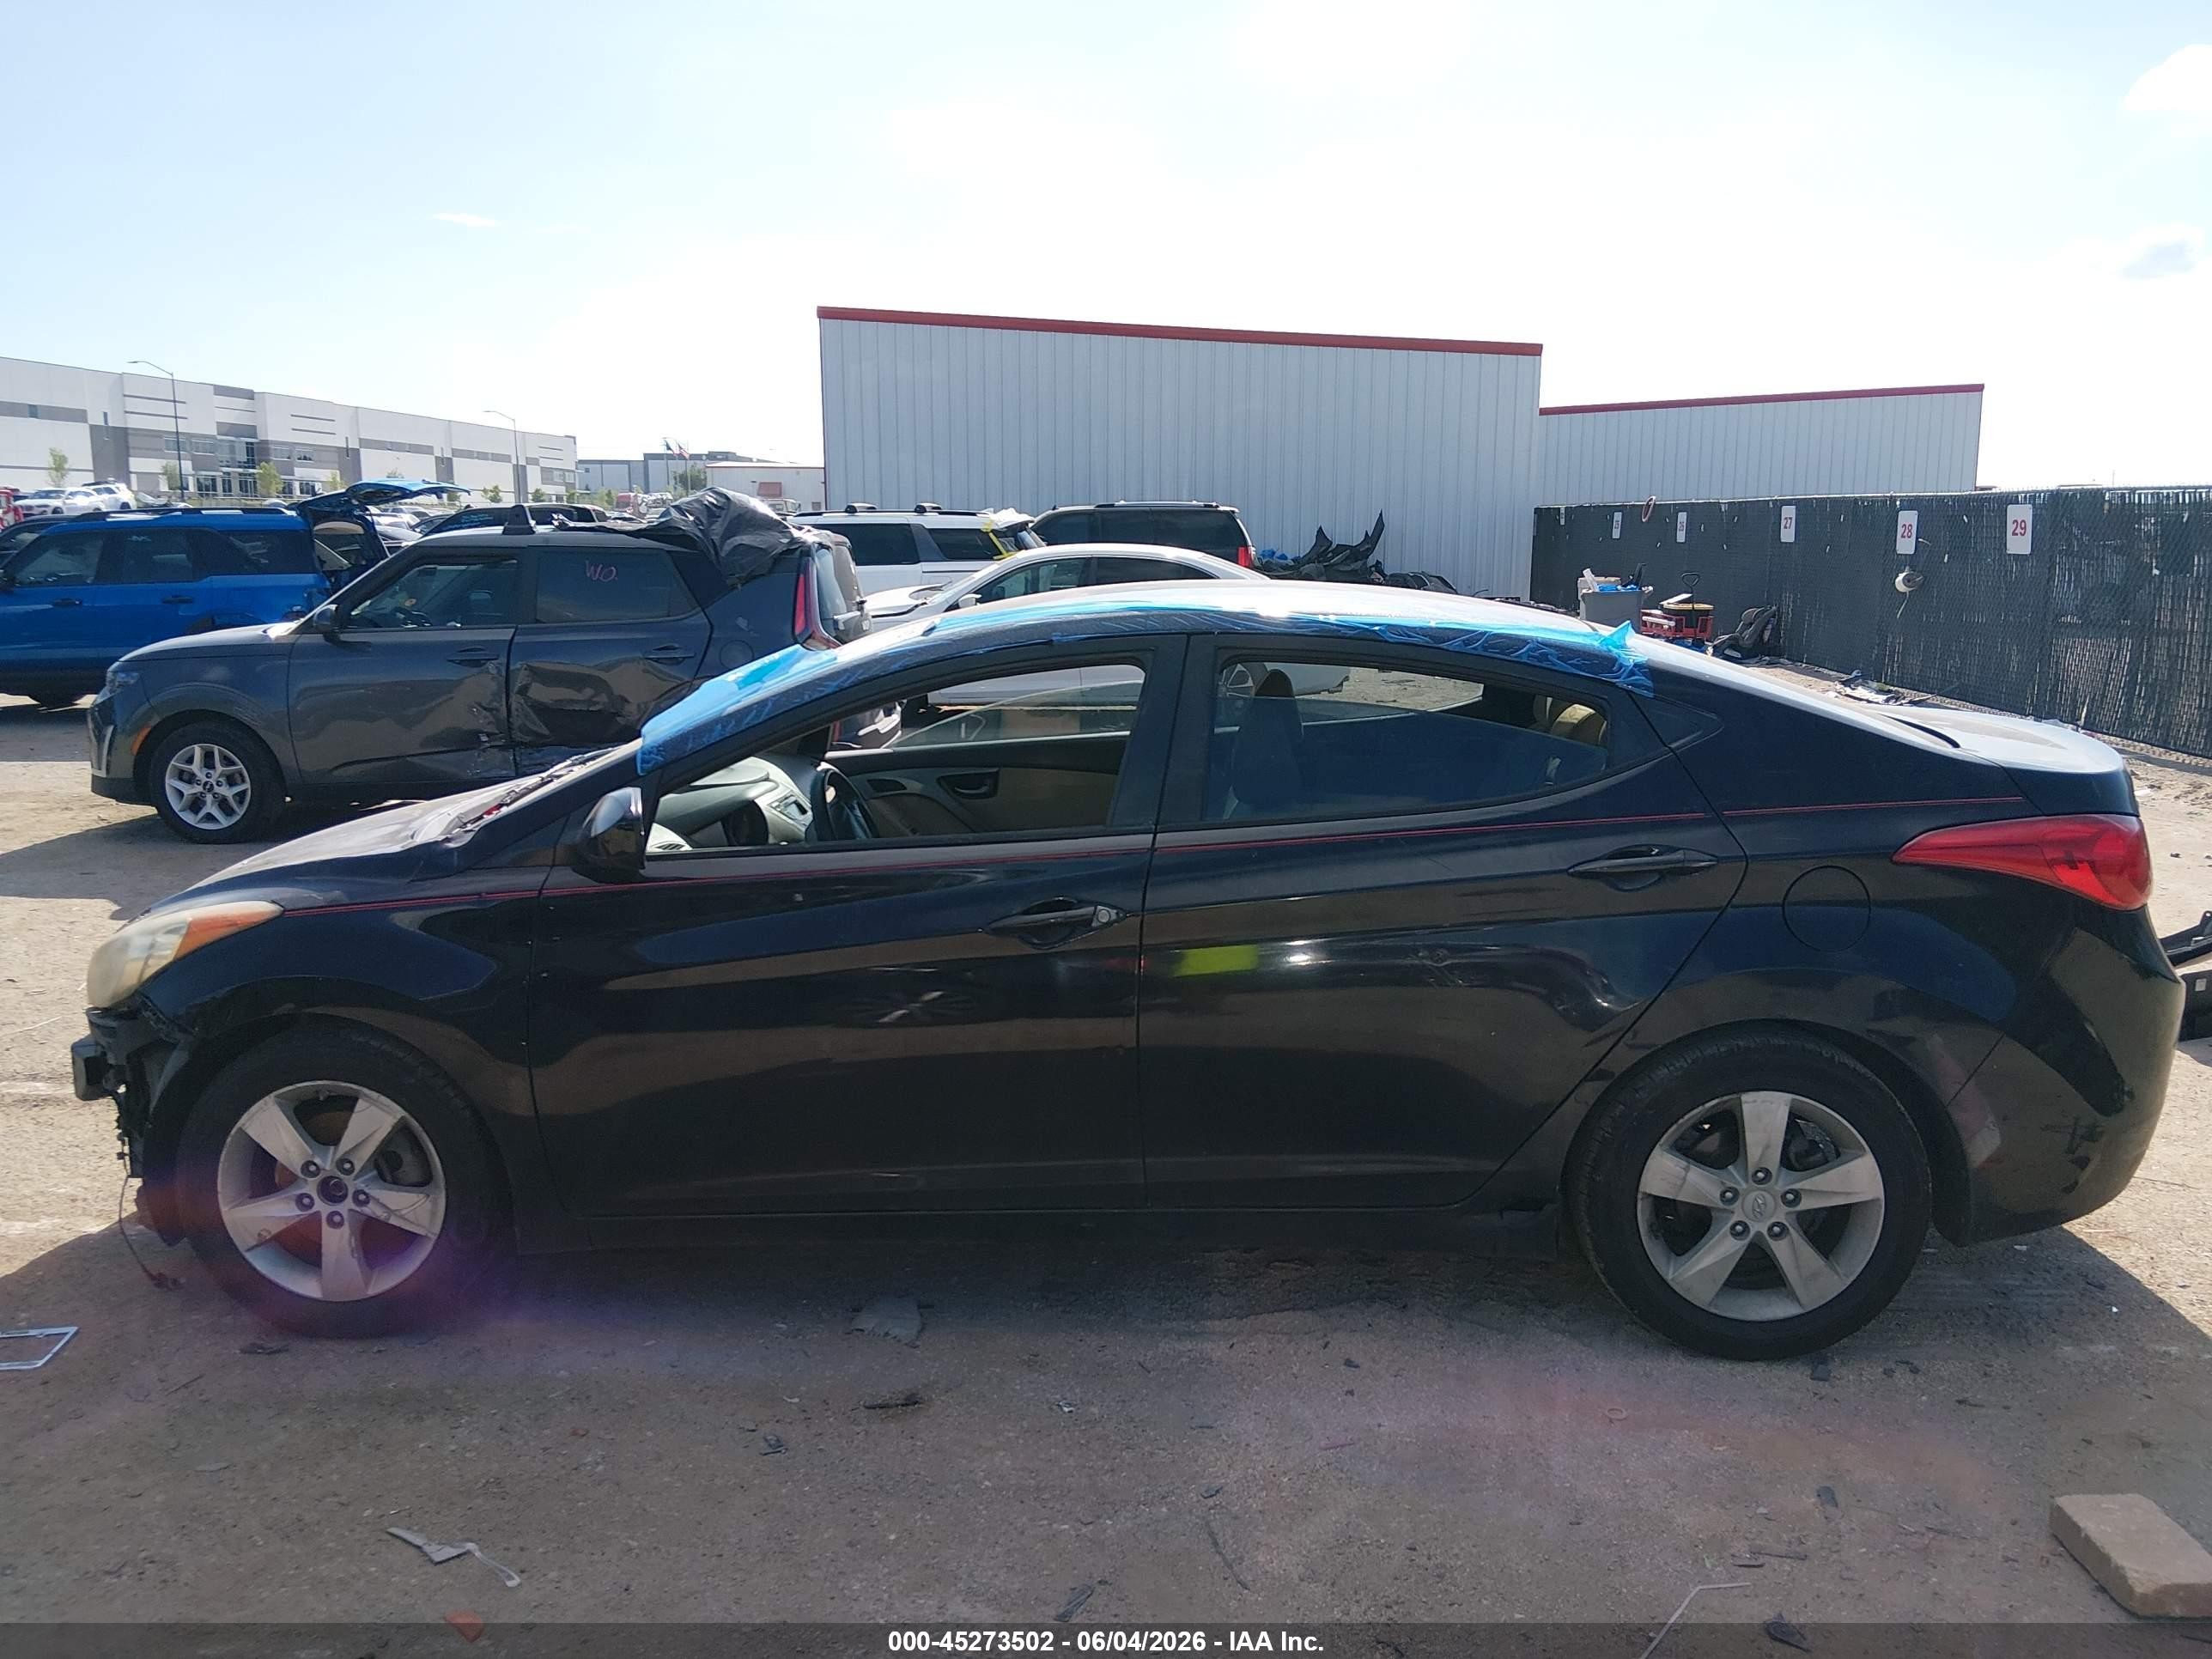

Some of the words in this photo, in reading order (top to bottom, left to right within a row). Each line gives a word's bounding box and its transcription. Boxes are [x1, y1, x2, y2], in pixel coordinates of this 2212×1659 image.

[1784, 517, 1793, 529] 27
[1900, 523, 1913, 538] 28
[2011, 519, 2027, 537] 29
